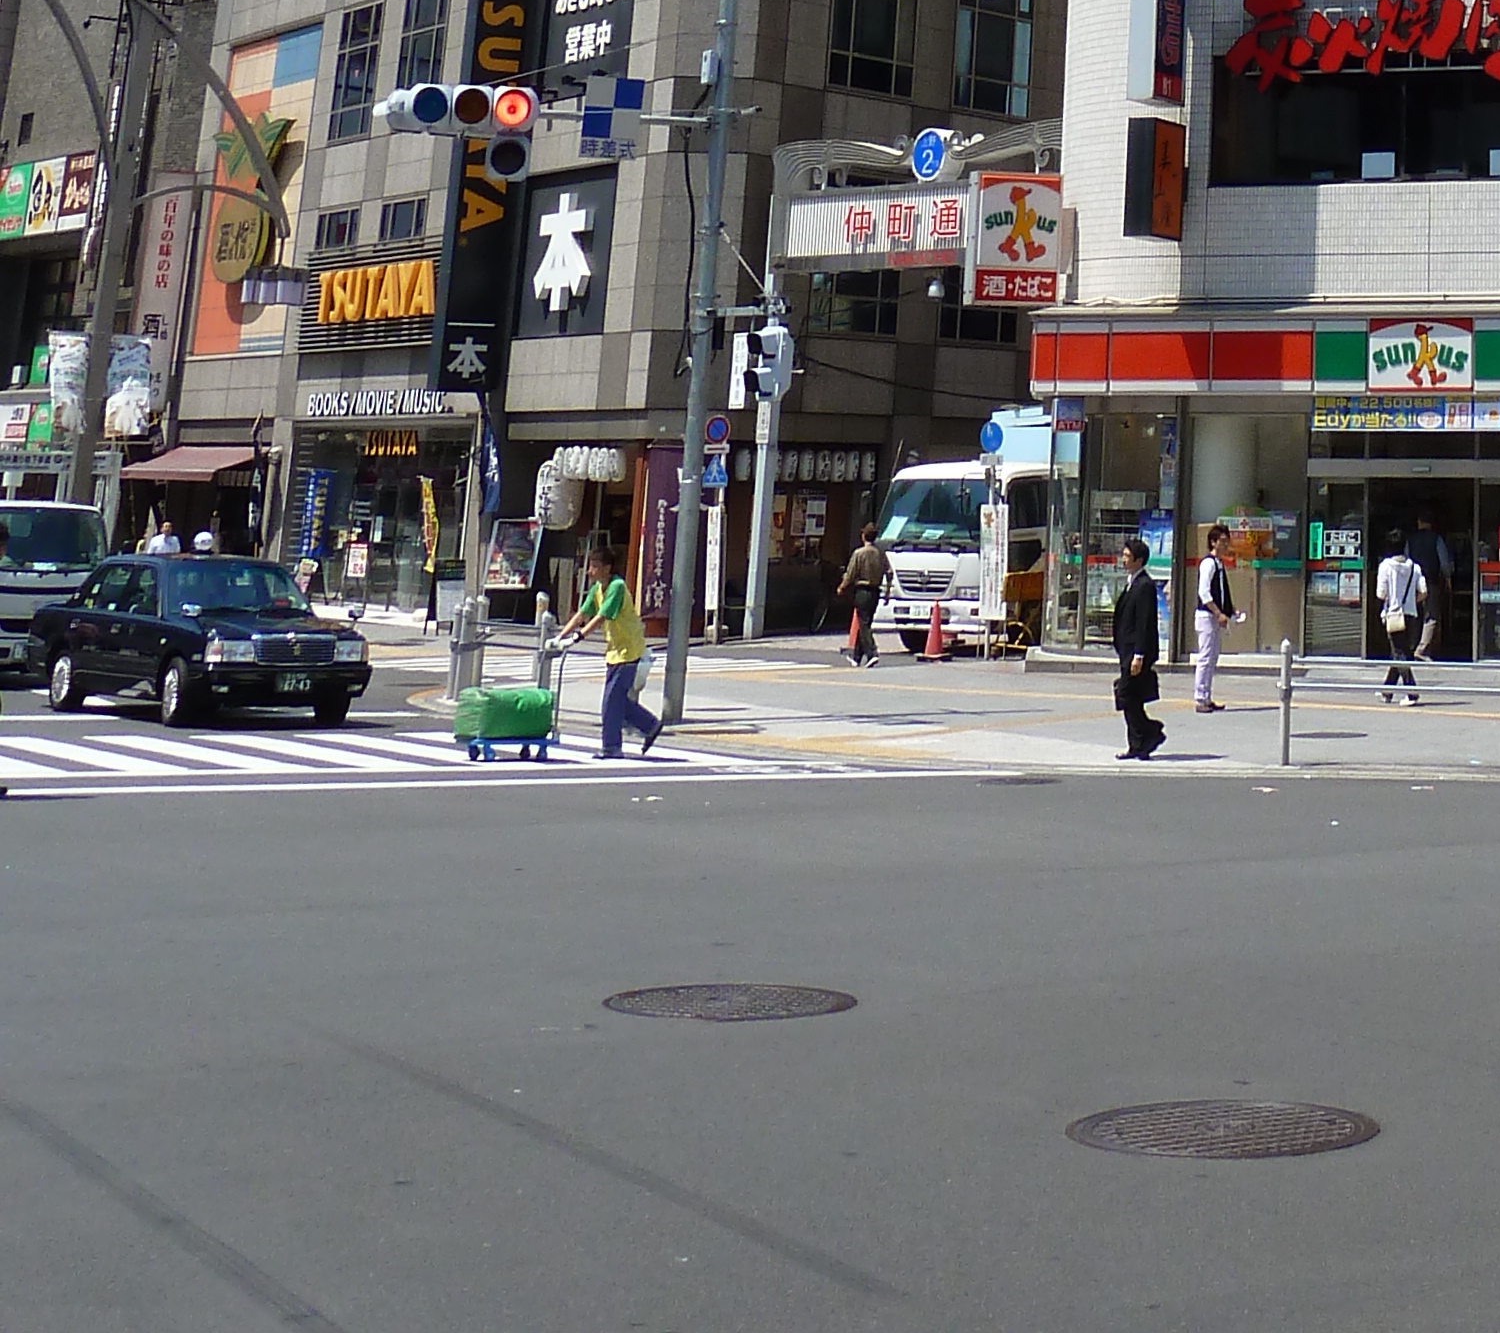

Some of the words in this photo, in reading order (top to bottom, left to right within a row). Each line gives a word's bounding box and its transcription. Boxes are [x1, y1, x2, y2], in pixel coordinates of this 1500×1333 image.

[563, 21, 612, 65] 営業中
[578, 137, 637, 160] 時差式
[921, 148, 935, 175] 2
[843, 197, 962, 244] 仲町通
[317, 260, 435, 324] TSUTAYA
[982, 275, 1053, 298] 酒・たばこ
[446, 335, 488, 380] 本
[307, 393, 348, 416] BOOKS
[1056, 419, 1084, 432] ATM
[364, 430, 418, 456] TSUTAYA
